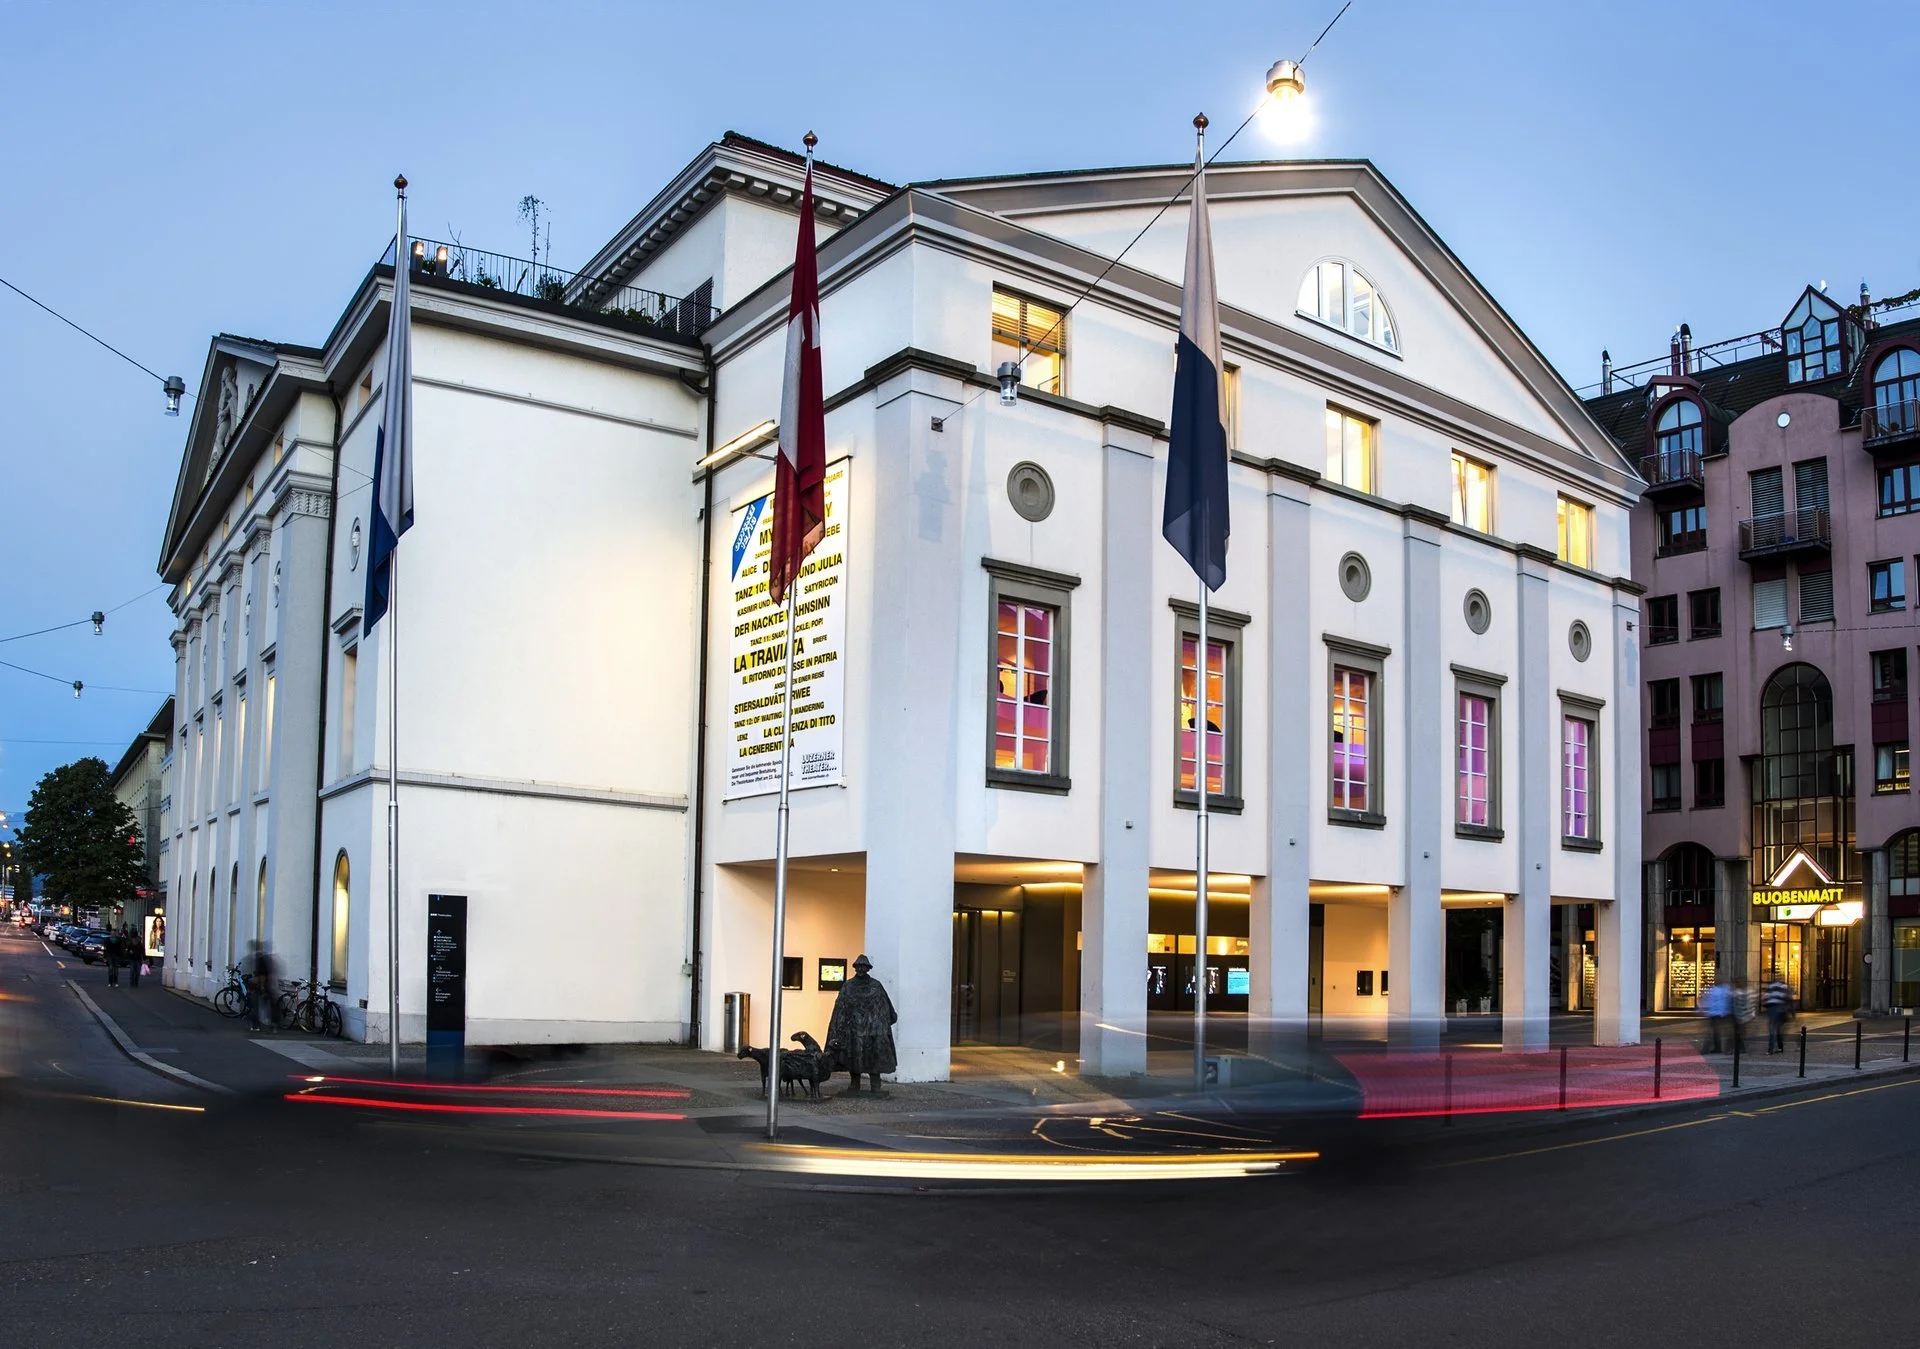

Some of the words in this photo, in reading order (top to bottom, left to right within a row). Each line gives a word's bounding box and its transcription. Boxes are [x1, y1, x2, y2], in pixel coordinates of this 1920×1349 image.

[735, 586, 753, 602] TANZ
[756, 582, 766, 594] 10:
[800, 562, 816, 578] UND
[818, 552, 842, 572] JULIA
[742, 565, 758, 578] ALICE
[804, 575, 838, 594] SATYRICON
[737, 603, 758, 617] KASIMIR
[758, 599, 770, 609] UND
[734, 622, 750, 638] DER
[752, 610, 784, 632] NACKTE
[750, 637, 762, 646] TANZ
[772, 630, 785, 640] SNAP,
[813, 634, 828, 644] BRIEFE
[734, 654, 747, 674] LA
[742, 676, 748, 684] IL
[748, 668, 776, 682] RITORNO
[778, 660, 804, 676] D'USSE
[806, 658, 812, 667] IN
[814, 651, 837, 666] PATRIA
[798, 675, 810, 684] EINER
[812, 671, 824, 680] REISE
[734, 686, 811, 714] STIERSALDVÄTTRWEE
[734, 720, 746, 728] TANZ
[754, 716, 760, 724] OF
[762, 712, 782, 722] WAITING
[794, 702, 824, 715] WANDERING
[764, 728, 772, 738] LA
[774, 720, 808, 736] CLENZA
[810, 718, 818, 728] DI
[818, 714, 835, 726] TITO
[737, 733, 748, 742] LENZ
[740, 748, 748, 758] LA
[748, 738, 795, 754] CENERENTA
[802, 751, 835, 764] LUZERNER
[1752, 888, 1844, 905] BUOBENMATT
